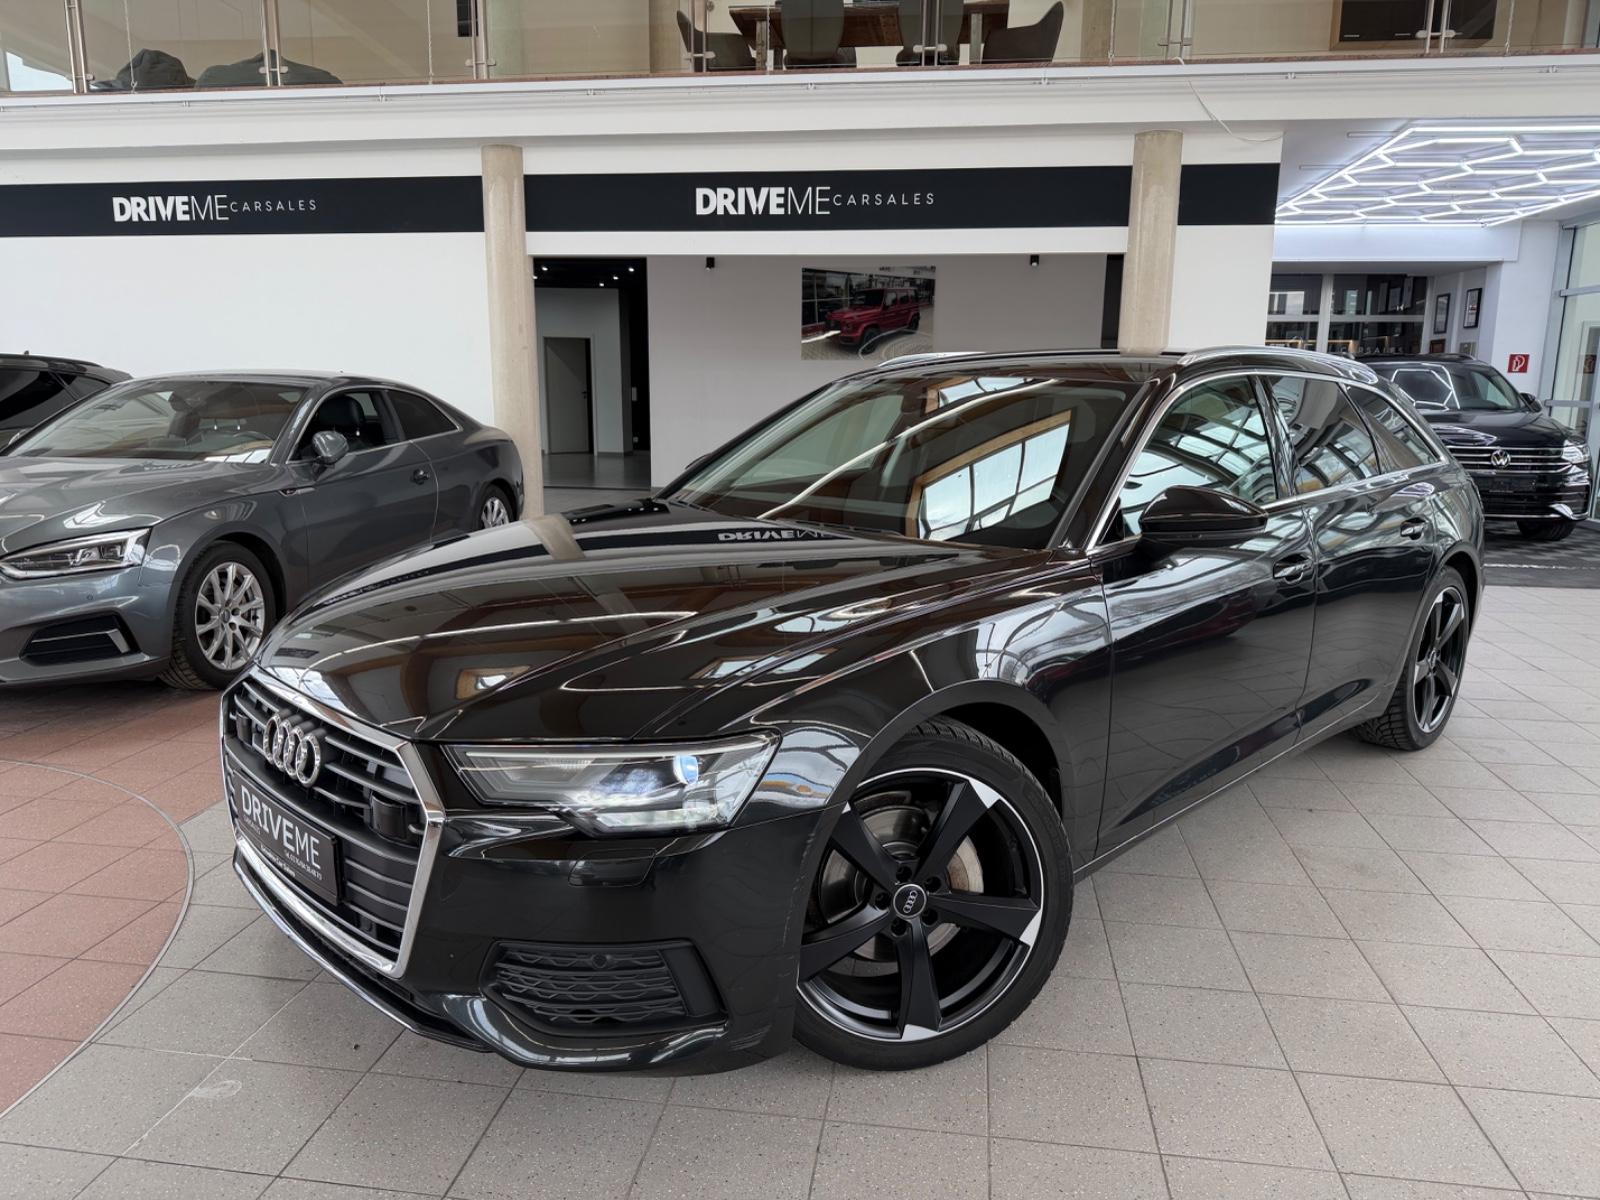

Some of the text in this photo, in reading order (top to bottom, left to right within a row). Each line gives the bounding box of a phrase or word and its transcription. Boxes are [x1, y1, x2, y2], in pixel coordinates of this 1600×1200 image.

[112, 195, 317, 222] DRIVEME CARSALES
[695, 186, 934, 215] DRIVEME CARSALES
[241, 785, 321, 870] DRIVEME
